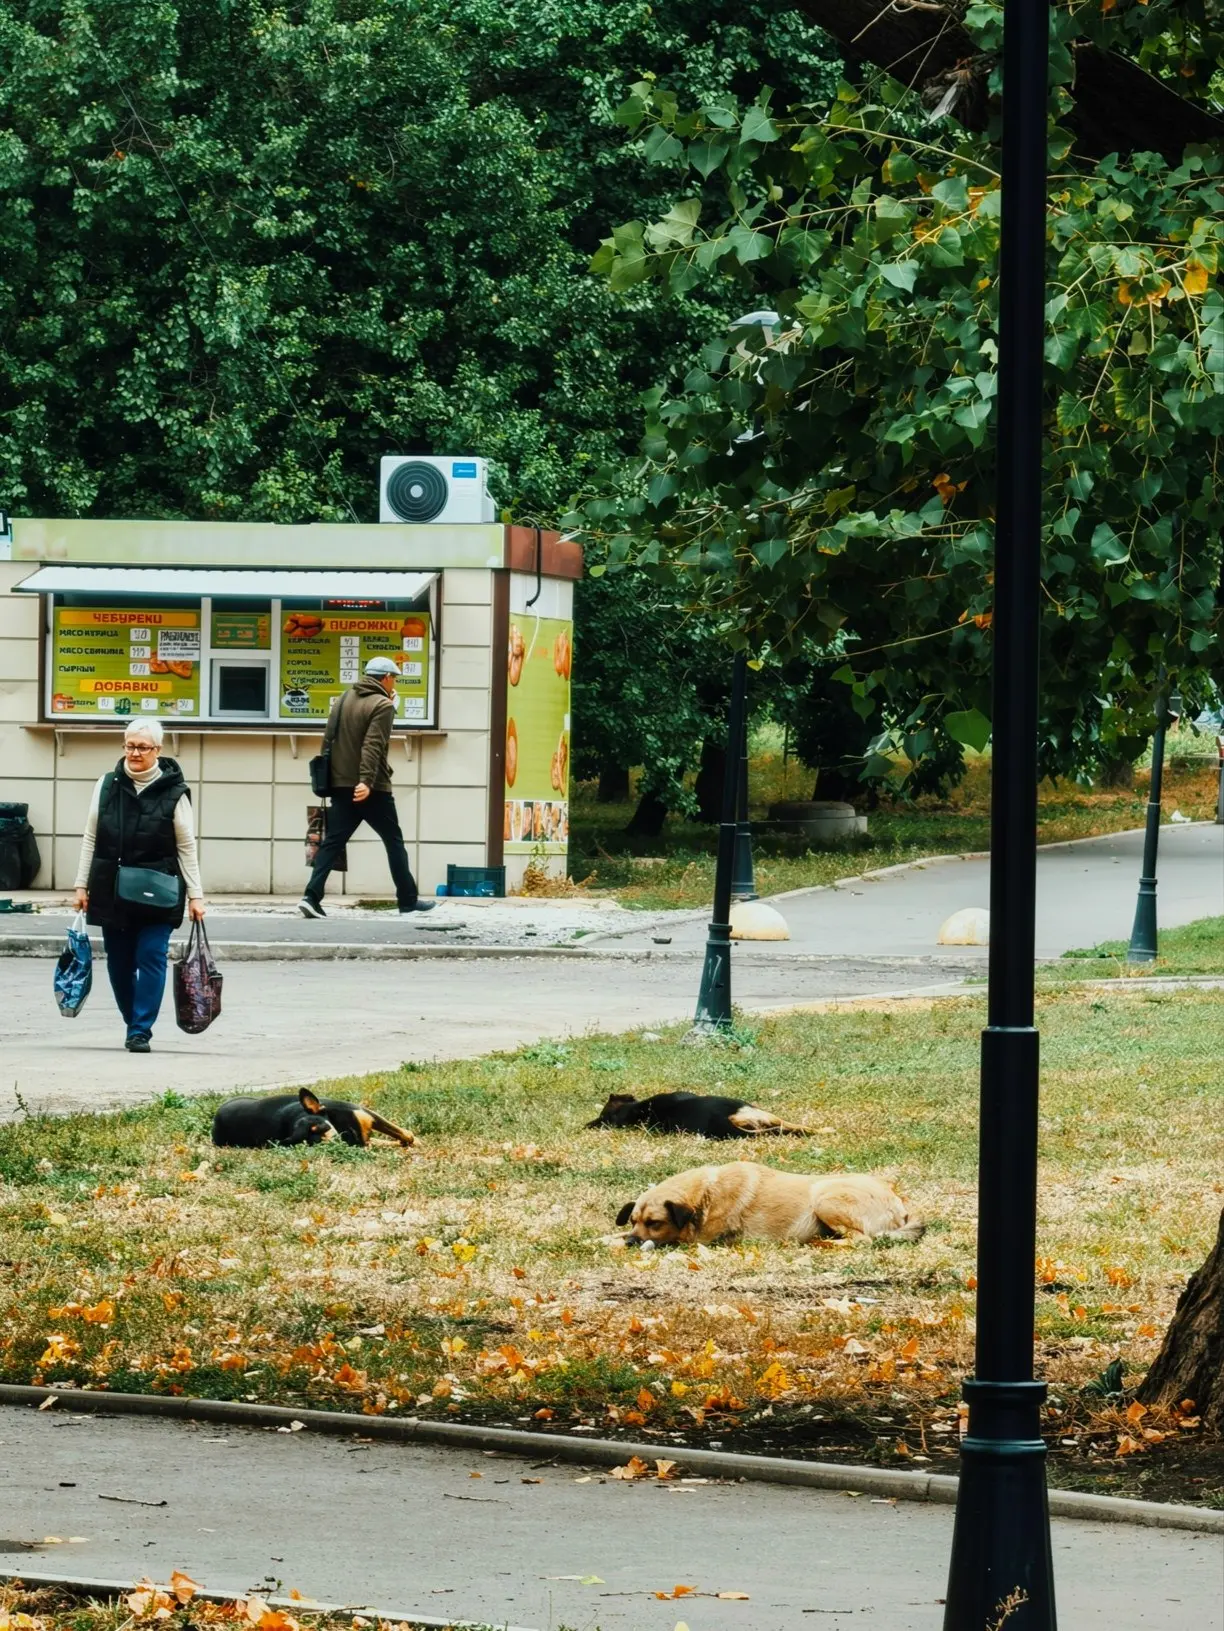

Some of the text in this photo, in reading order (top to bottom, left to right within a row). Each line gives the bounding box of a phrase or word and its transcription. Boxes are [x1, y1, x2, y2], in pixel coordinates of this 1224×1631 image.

[93, 613, 163, 624] ЧЕБУРЕКИ
[330, 620, 398, 631] ПИРОЖКИ
[94, 681, 159, 692] ДОБАВКИ
